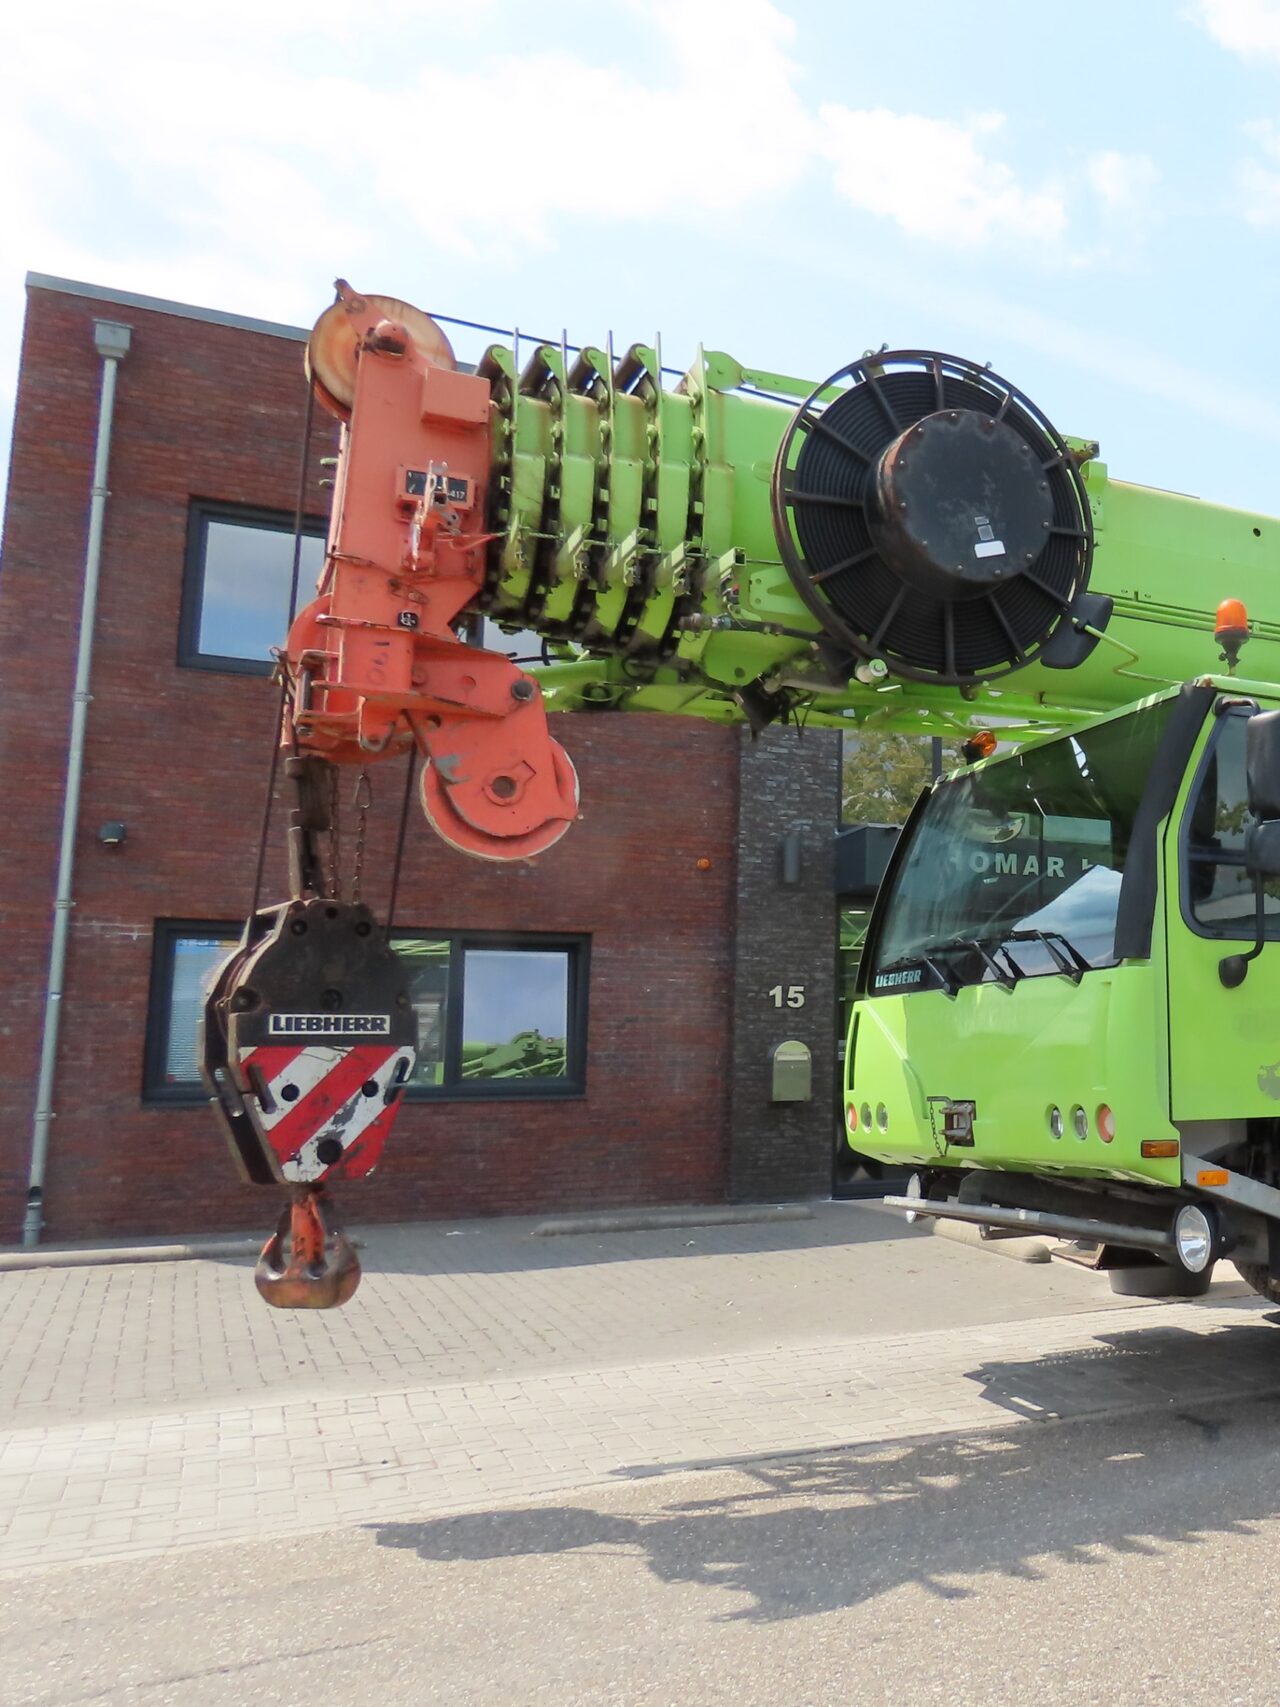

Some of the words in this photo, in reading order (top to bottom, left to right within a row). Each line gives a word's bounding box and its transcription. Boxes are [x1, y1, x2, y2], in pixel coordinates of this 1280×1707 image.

[875, 969, 922, 988] LIEBHERR
[769, 985, 805, 1008] 15
[272, 1016, 387, 1032] LIEBHERR
